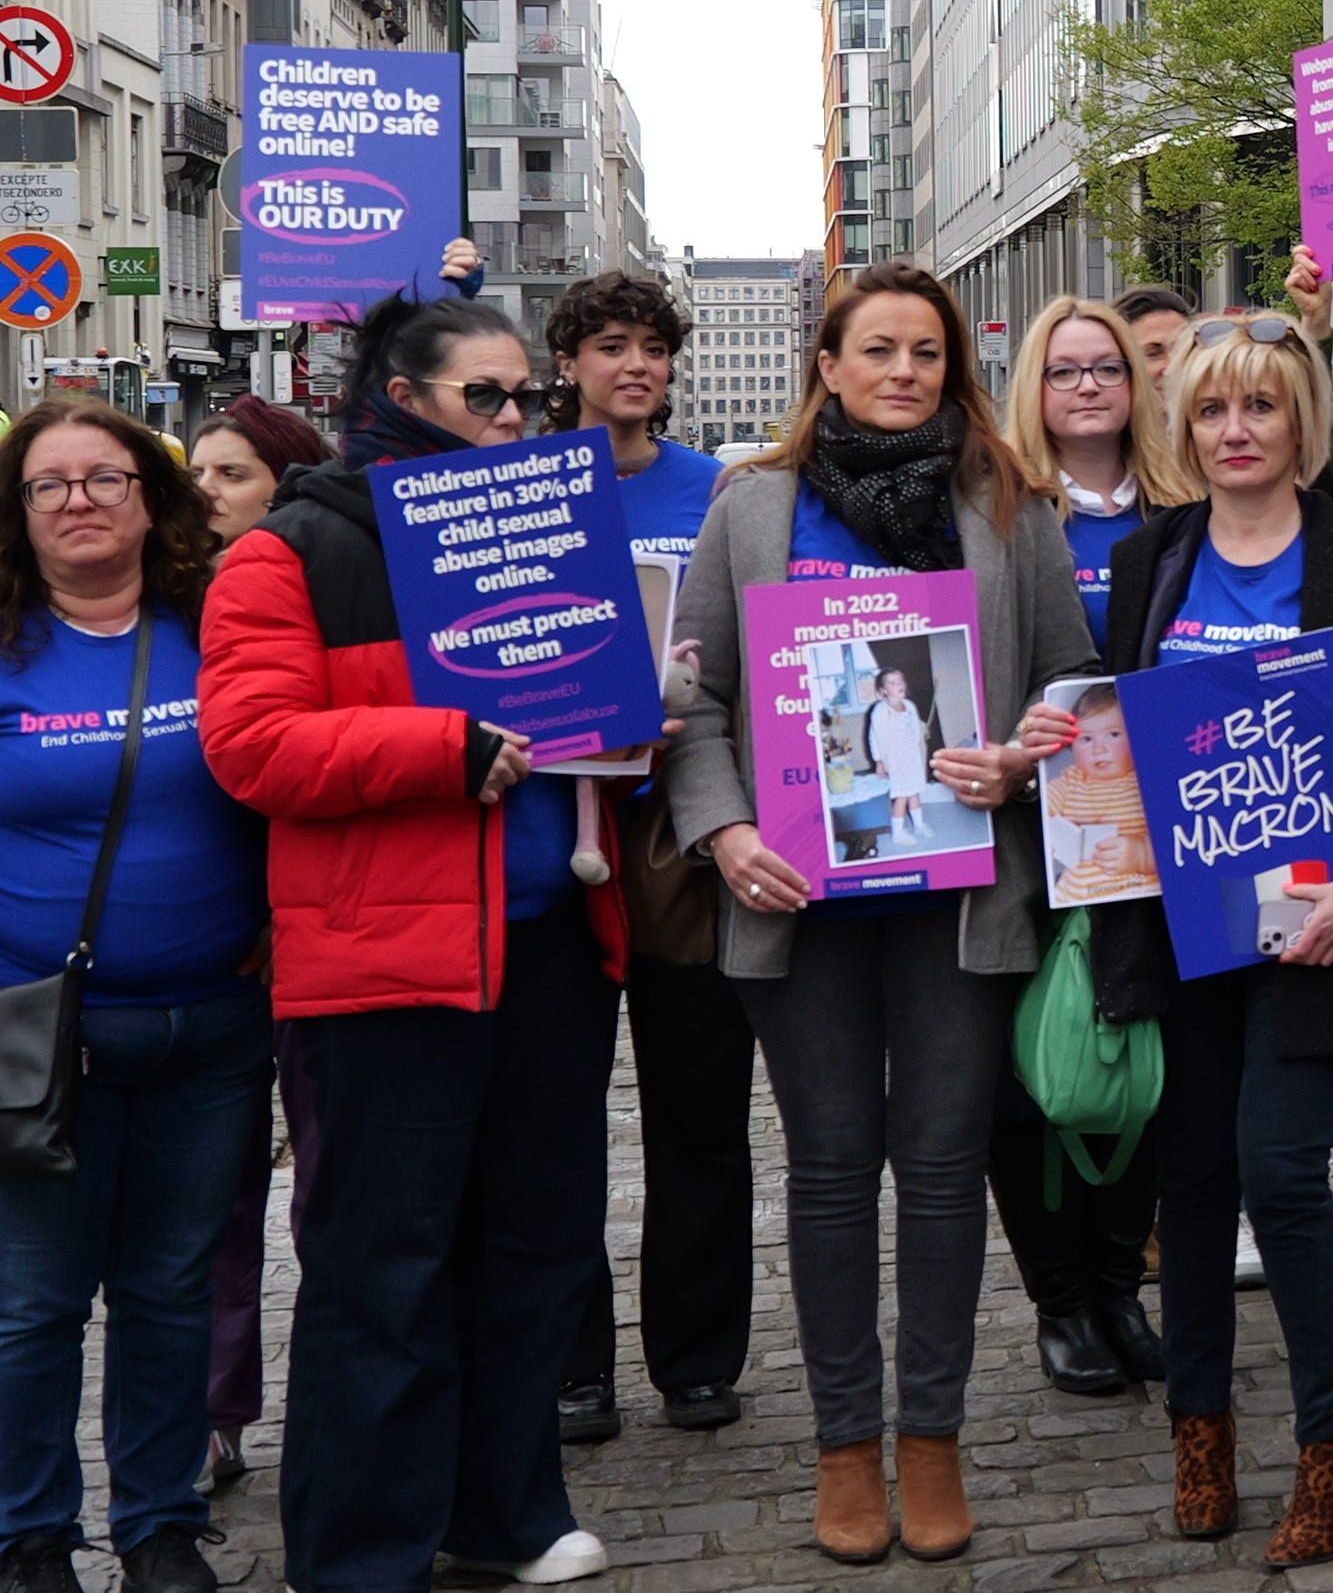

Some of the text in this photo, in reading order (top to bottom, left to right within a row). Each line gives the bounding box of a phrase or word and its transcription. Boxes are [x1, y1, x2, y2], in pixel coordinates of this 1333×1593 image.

[258, 59, 377, 87] Children
[258, 84, 441, 112] deserve to be
[258, 108, 440, 136] free AND safe
[258, 132, 356, 158] online!
[0, 175, 48, 185] EXCEPTE
[258, 180, 345, 205] This is
[258, 206, 404, 231] OUR DUTY
[263, 304, 295, 315] brave
[393, 446, 594, 500] Children under 10
[403, 470, 595, 526] feature in 30% of
[437, 502, 573, 547] child sexual
[432, 529, 588, 576] abuse images
[475, 563, 556, 594] online.
[823, 593, 899, 617] In 2022
[430, 599, 618, 653] We must protect
[794, 613, 931, 643] more horrific
[498, 639, 563, 667] them
[1257, 648, 1327, 674] movement
[20, 711, 101, 734] brave
[41, 733, 68, 748] End
[142, 723, 187, 739] Sexual
[1185, 690, 1296, 756] #BE
[783, 768, 810, 787] EU
[1178, 734, 1325, 812] BRAVE
[862, 873, 923, 890] movement
